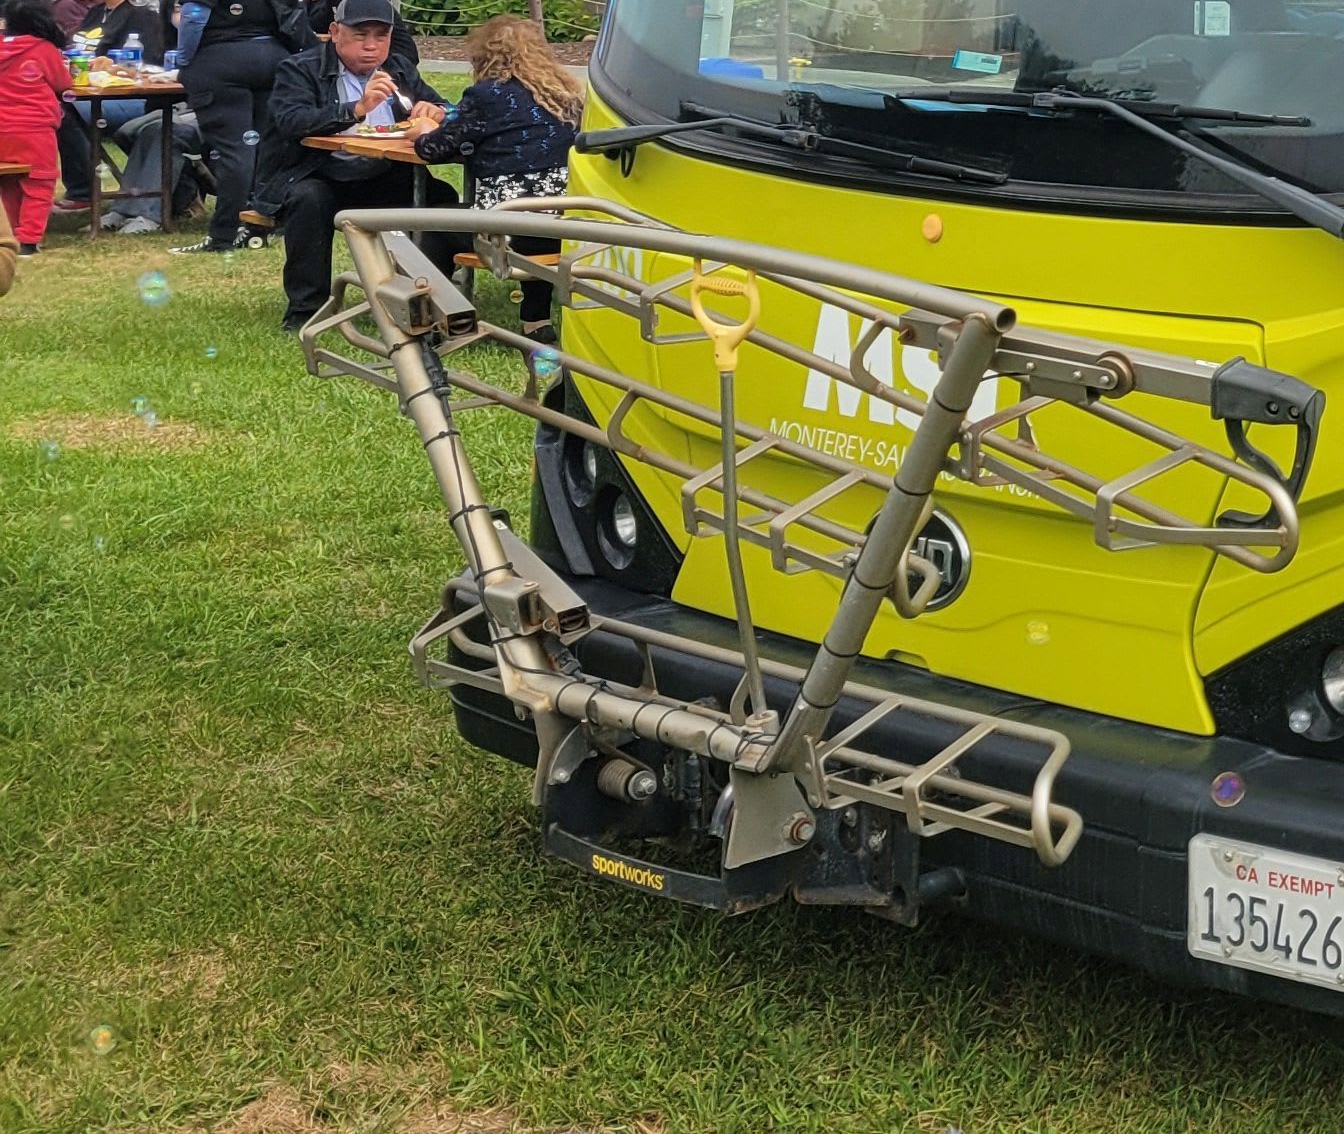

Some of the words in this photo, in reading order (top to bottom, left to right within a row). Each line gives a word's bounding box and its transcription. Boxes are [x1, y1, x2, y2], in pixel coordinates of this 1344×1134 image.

[592, 854, 664, 891] sportworks
[1236, 865, 1258, 884] CA
[1268, 871, 1335, 899] EXEMPT
